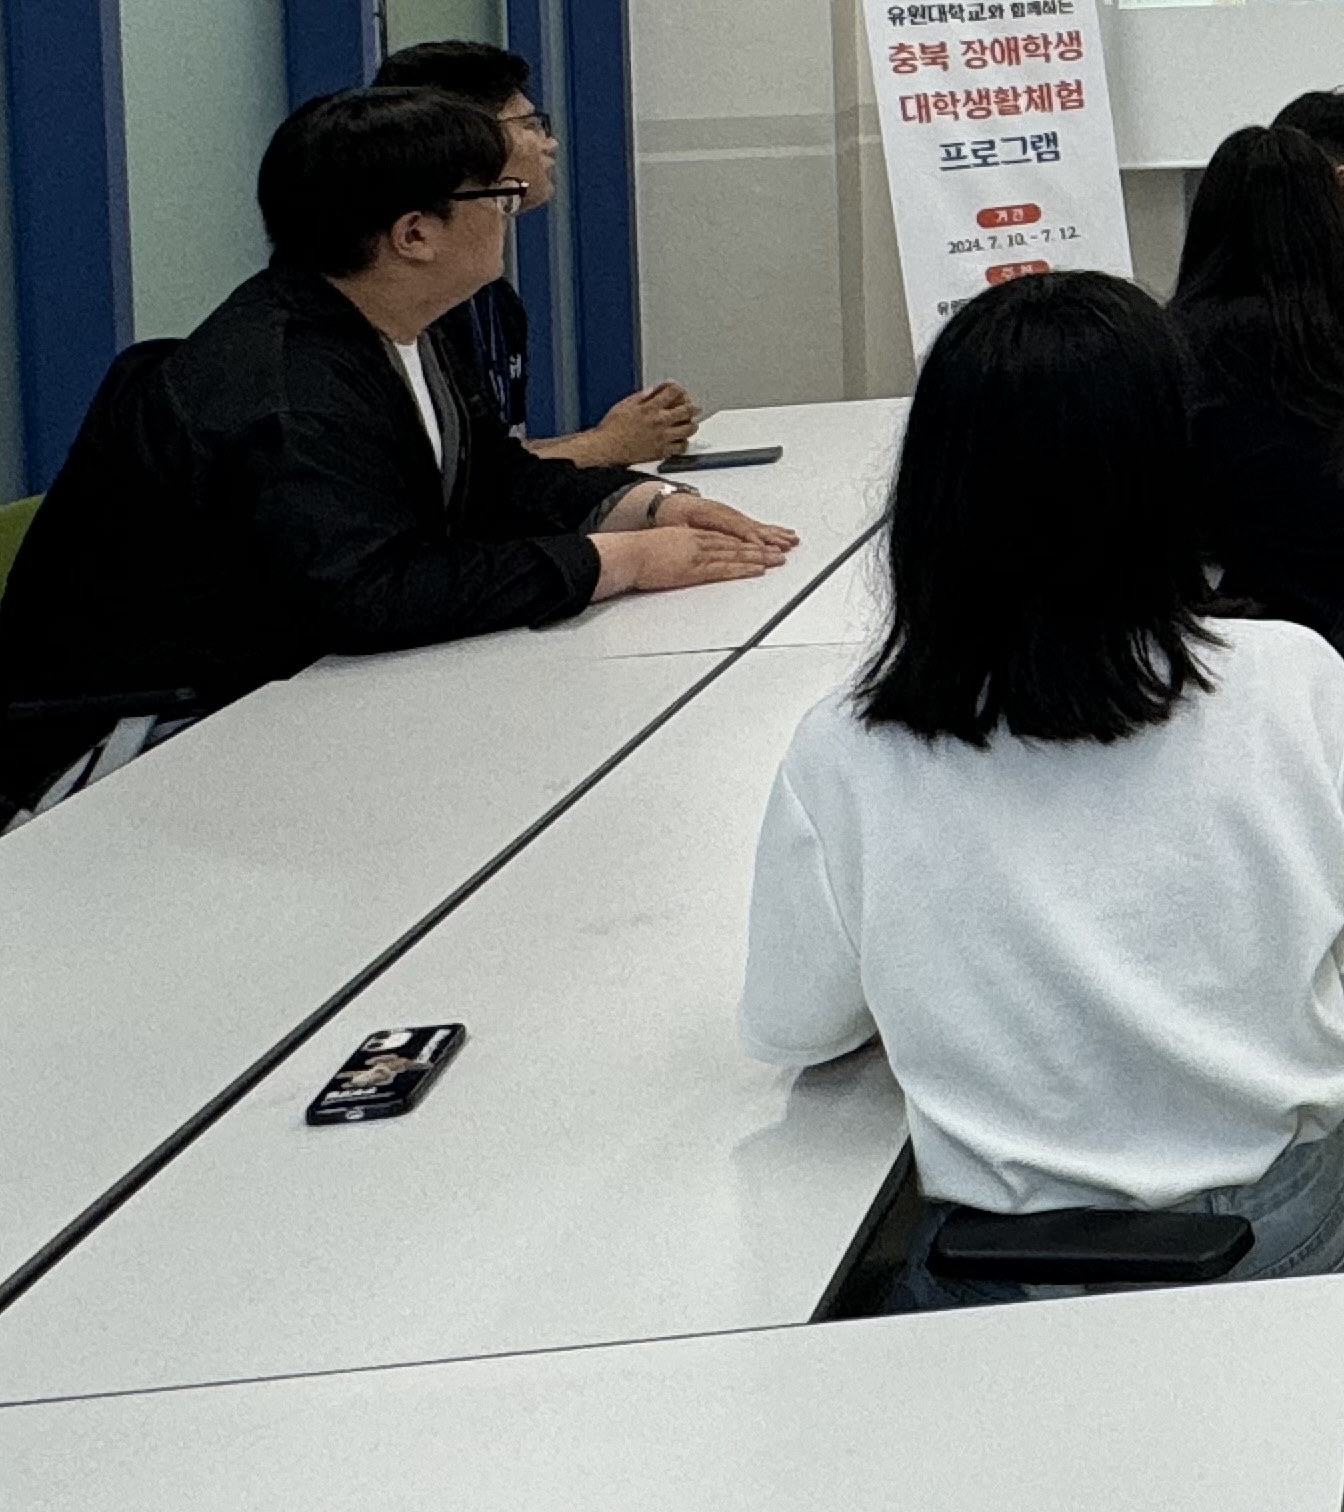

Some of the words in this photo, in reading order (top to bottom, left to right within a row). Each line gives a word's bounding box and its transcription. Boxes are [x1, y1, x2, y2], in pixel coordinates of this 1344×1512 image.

[887, 2, 1005, 27] 유원대학교와
[888, 40, 949, 74] 충북
[960, 29, 1084, 70] 장애학생
[898, 79, 1085, 124] 대학생활체험
[939, 131, 1061, 171] 프로그램
